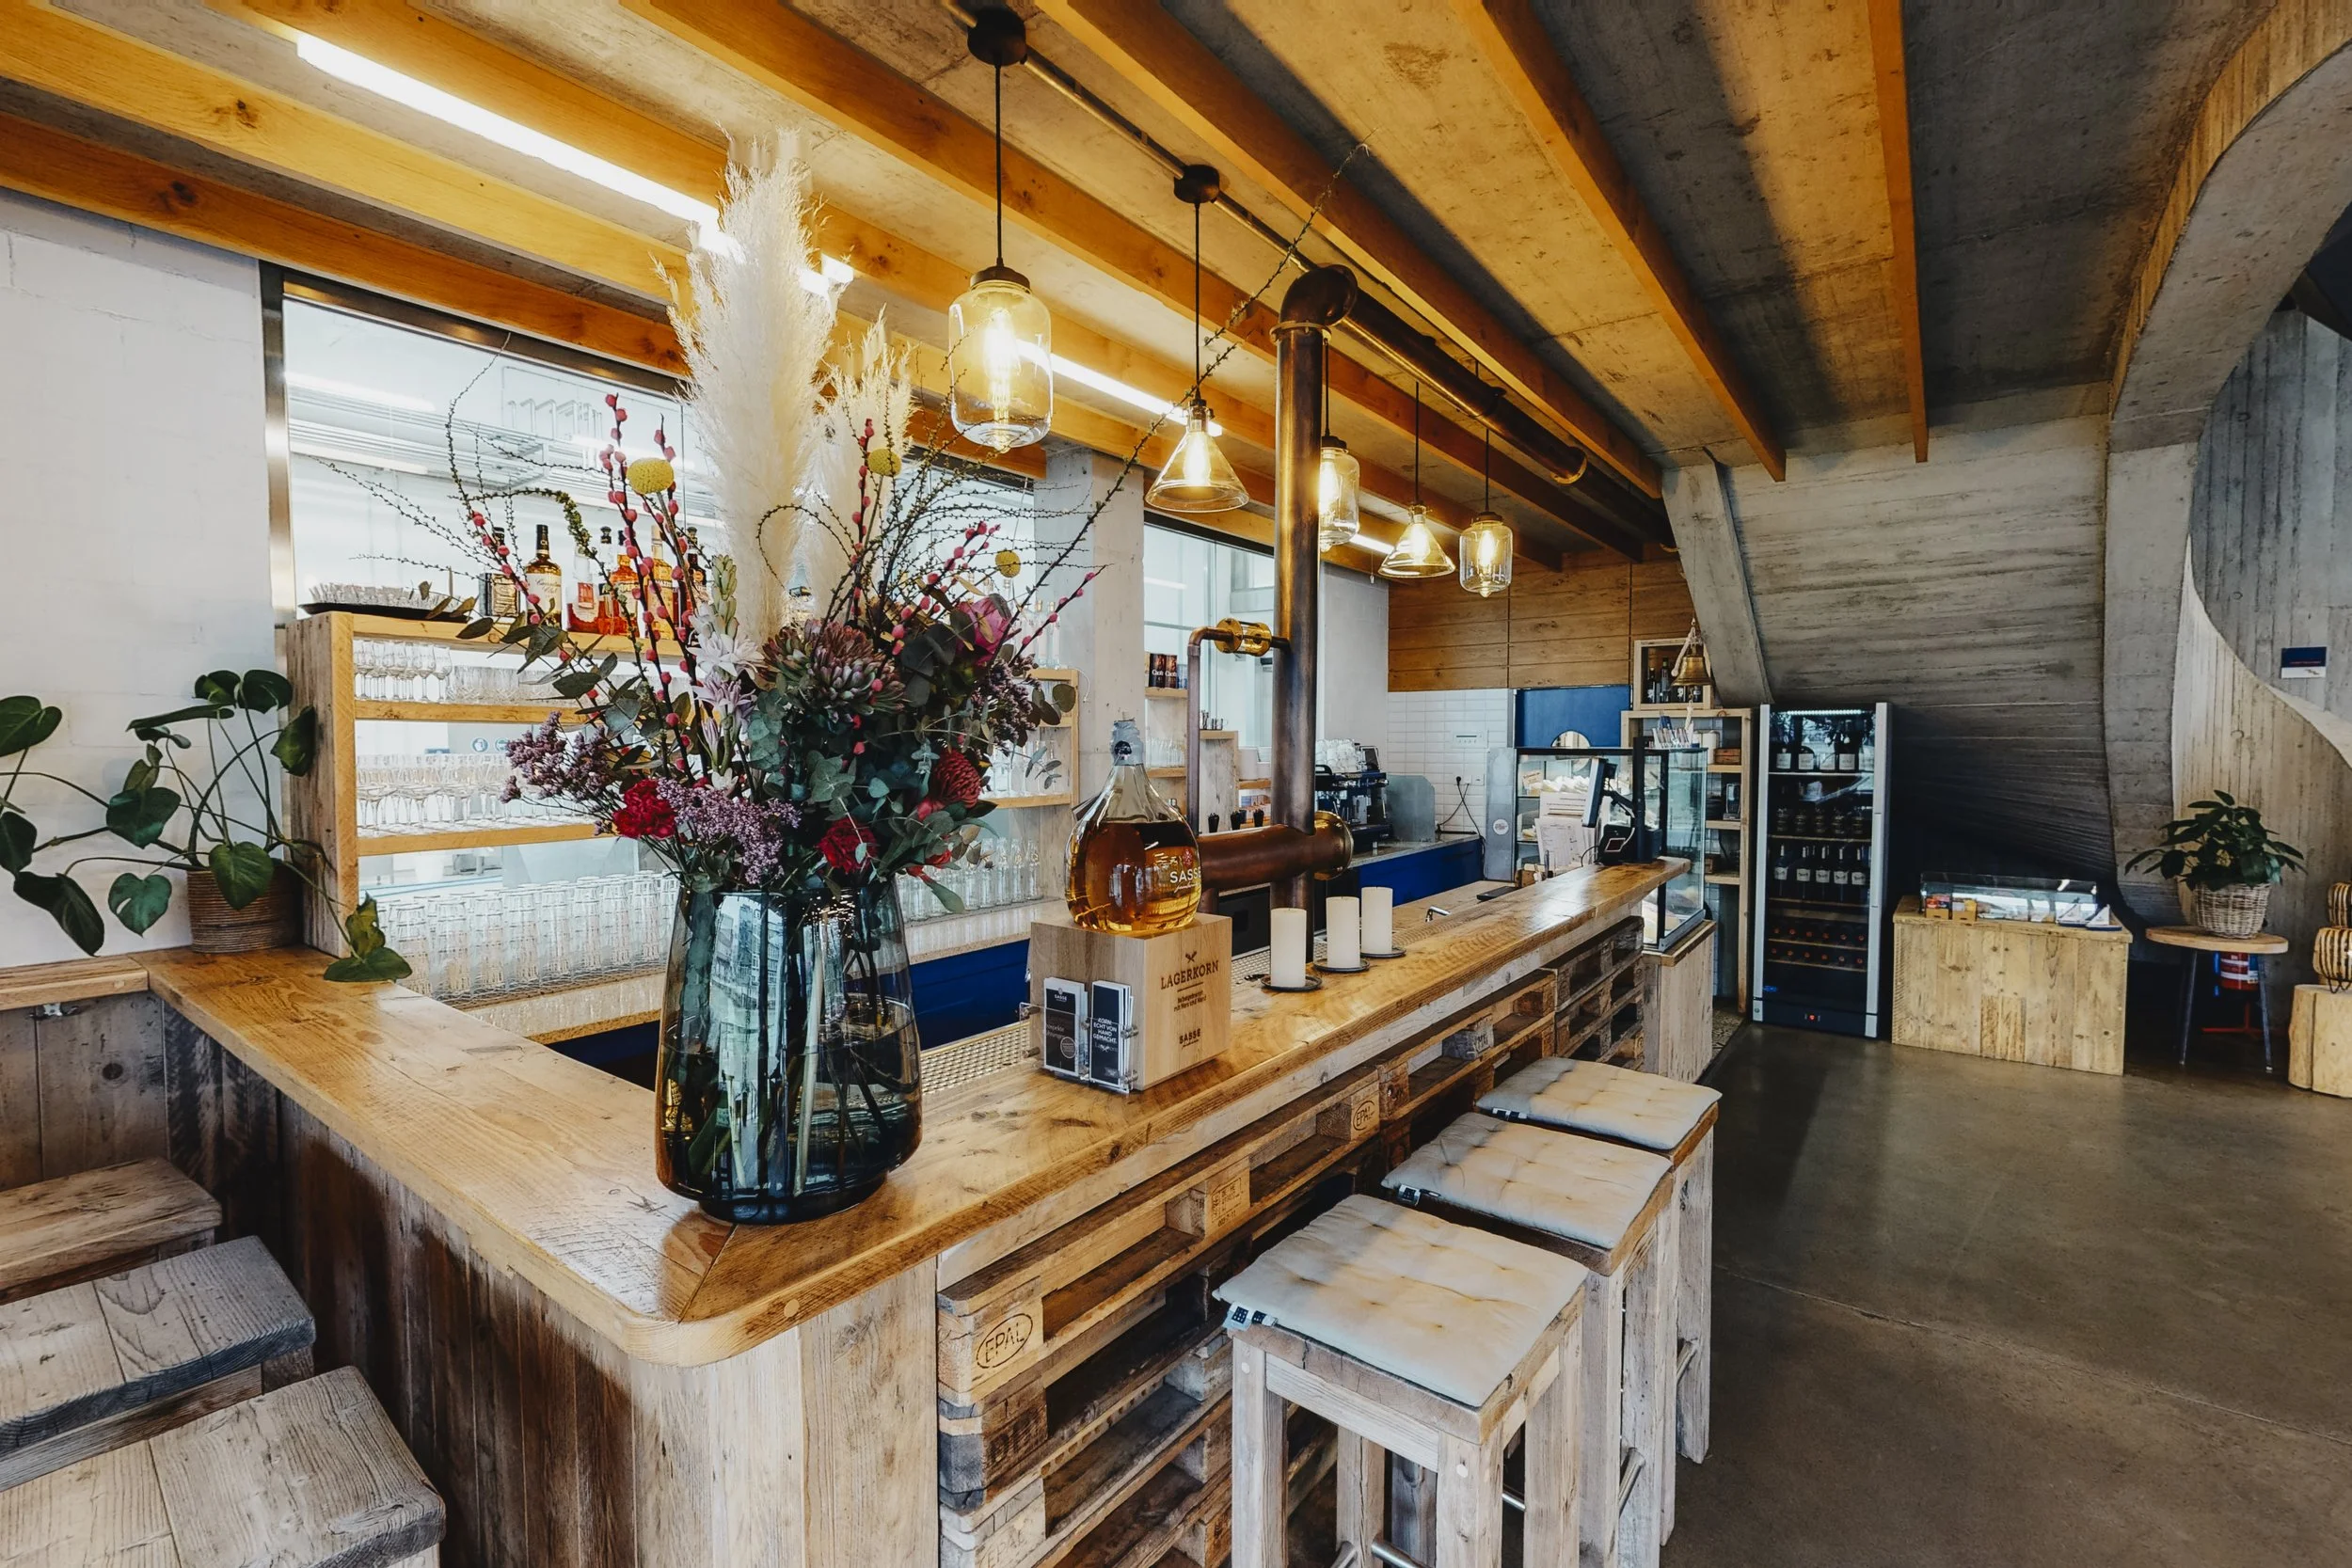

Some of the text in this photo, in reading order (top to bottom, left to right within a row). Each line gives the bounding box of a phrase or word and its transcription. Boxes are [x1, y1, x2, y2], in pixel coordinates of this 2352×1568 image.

[1160, 959, 1219, 990] LAGERKORN
[1105, 1024, 1118, 1033] VON
[1179, 1028, 1201, 1044] SASSE
[985, 1323, 1025, 1364] EPAL
